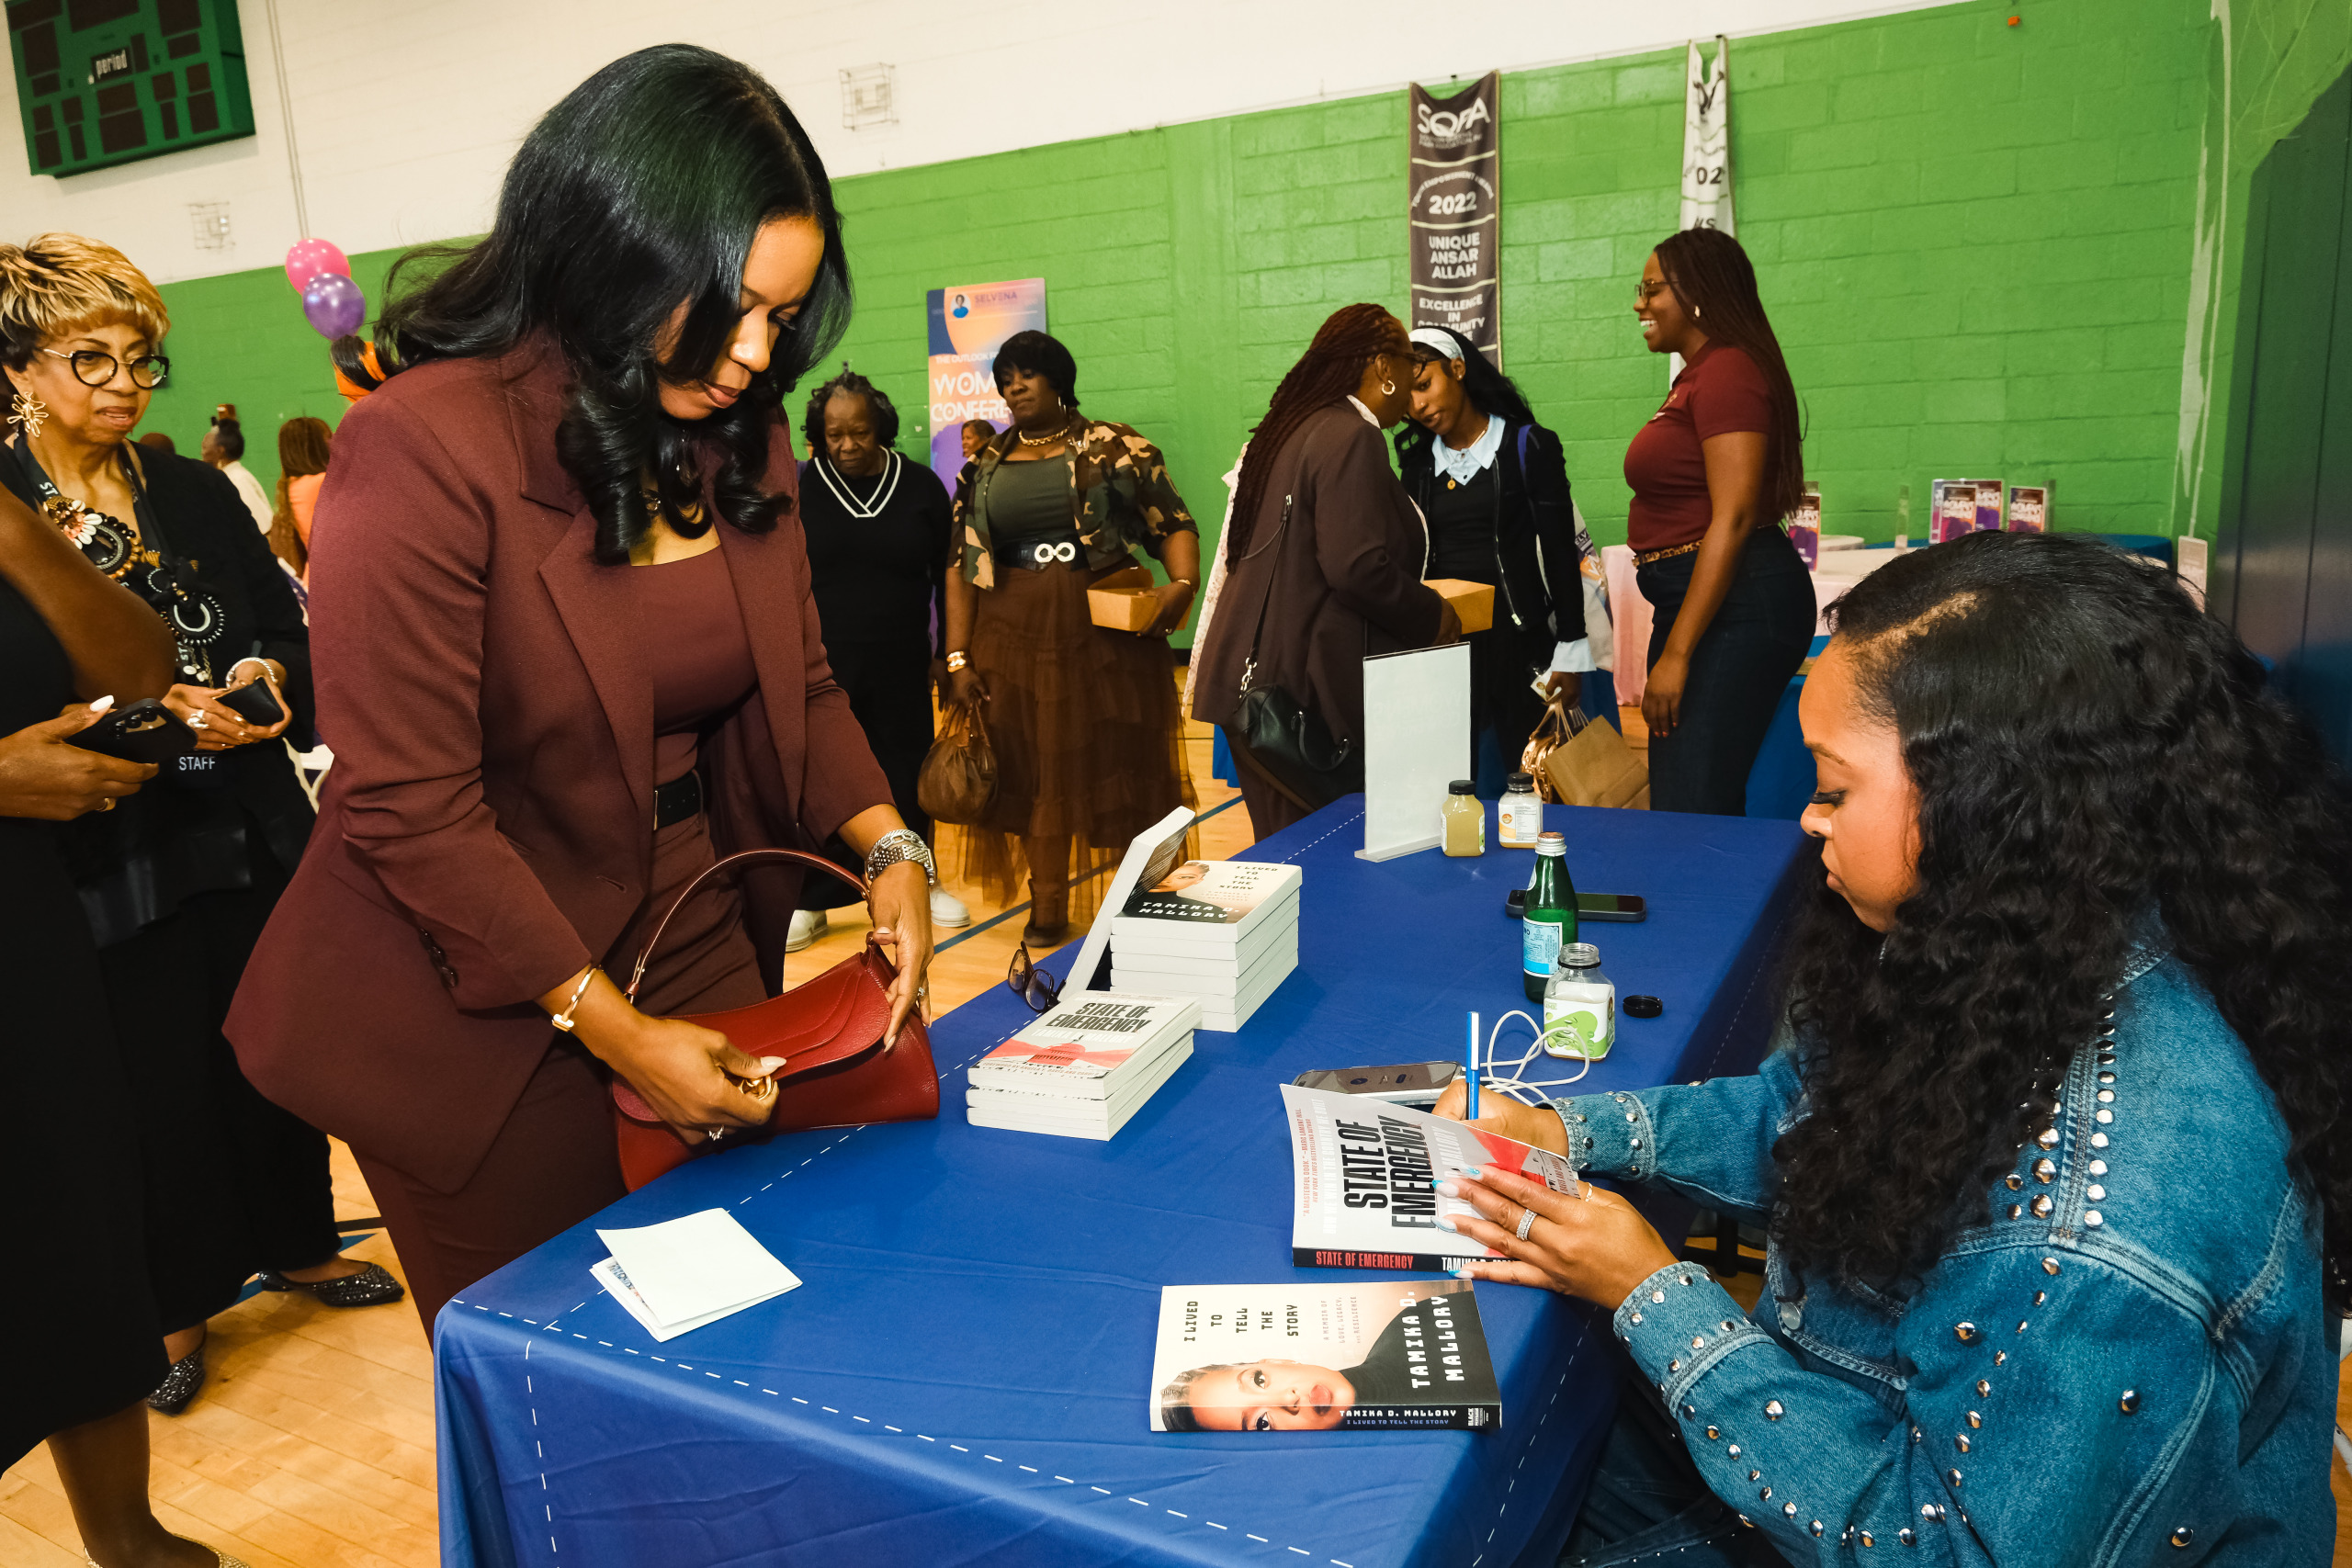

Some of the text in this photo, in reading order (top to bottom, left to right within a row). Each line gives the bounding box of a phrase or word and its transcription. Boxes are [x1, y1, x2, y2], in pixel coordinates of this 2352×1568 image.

[96, 49, 128, 79] period
[1429, 191, 1477, 215] 2022
[1429, 231, 1480, 250] UNIQUE
[1430, 248, 1479, 265] ANSAR
[1431, 263, 1477, 279] ALLAH
[1419, 294, 1483, 311] EXCELLENCE
[1448, 311, 1461, 322] IN
[933, 371, 997, 397] WOM
[931, 399, 1012, 423] CONFERE
[178, 757, 216, 771] STAFF
[1138, 908, 1227, 919] MALLORY
[1142, 902, 1214, 911] TAMIKA
[1075, 1003, 1156, 1018] STATE OF
[1046, 1014, 1152, 1032] EMERGENCY
[1308, 1134, 1317, 1161] BESTSELLING
[1317, 1126, 1335, 1156] COUNTRY
[1321, 1156, 1336, 1170] THE
[1336, 1119, 1387, 1209] STATE OF
[1378, 1115, 1437, 1229] EMERGENCY
[1316, 1251, 1342, 1266] STATE
[1345, 1253, 1356, 1267] OF
[1358, 1253, 1413, 1269] EMERGENCY
[1185, 1301, 1198, 1332] LIVED
[1211, 1315, 1222, 1326] TO
[1236, 1308, 1248, 1333] TELL
[1261, 1312, 1273, 1330] THE
[1286, 1304, 1299, 1336] STORY
[1351, 1297, 1360, 1334] RESILIENCE
[1400, 1292, 1431, 1389] TAMIKA D.
[1430, 1296, 1464, 1382] MALLORY
